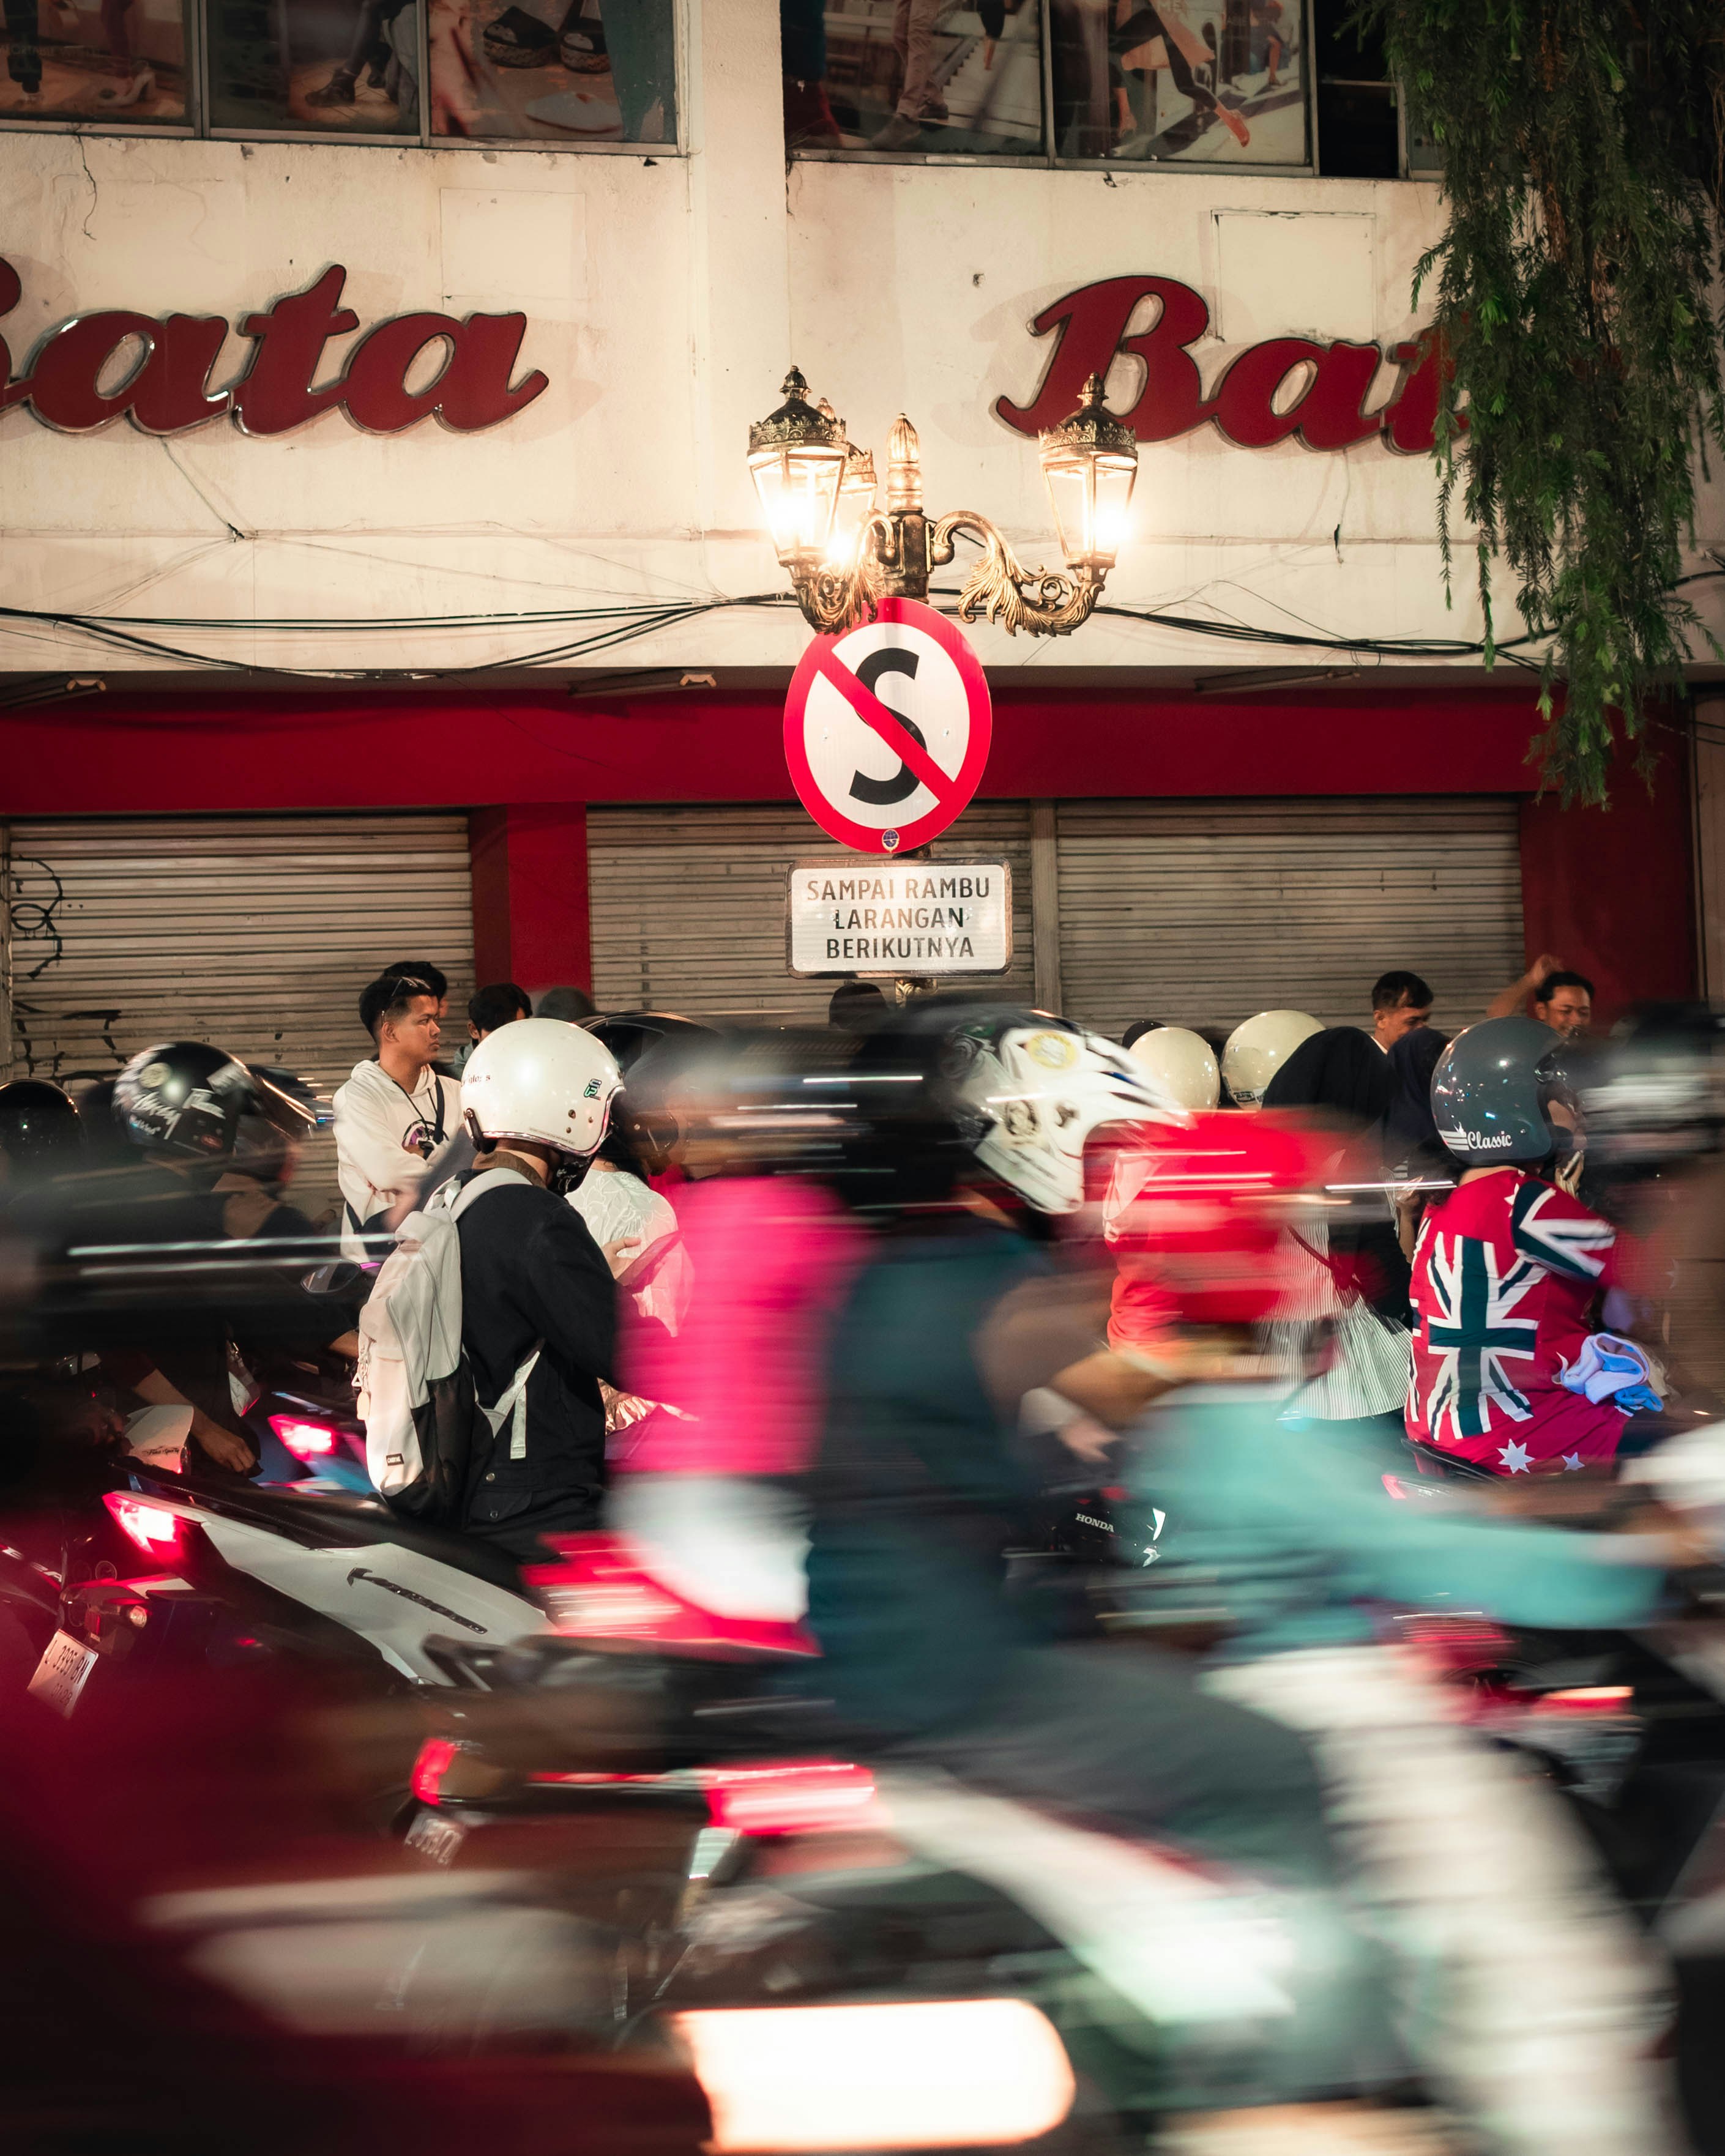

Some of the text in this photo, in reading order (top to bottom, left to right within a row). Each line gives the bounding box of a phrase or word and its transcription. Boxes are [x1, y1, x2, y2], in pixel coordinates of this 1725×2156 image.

[848, 647, 928, 805] S
[807, 877, 989, 901] SAMPAI RAMBU
[834, 907, 963, 929] LARANGAN
[827, 937, 974, 959] BERIKUTNYA
[1467, 1131, 1513, 1150] Classic
[1075, 1513, 1114, 1533] HONDA
